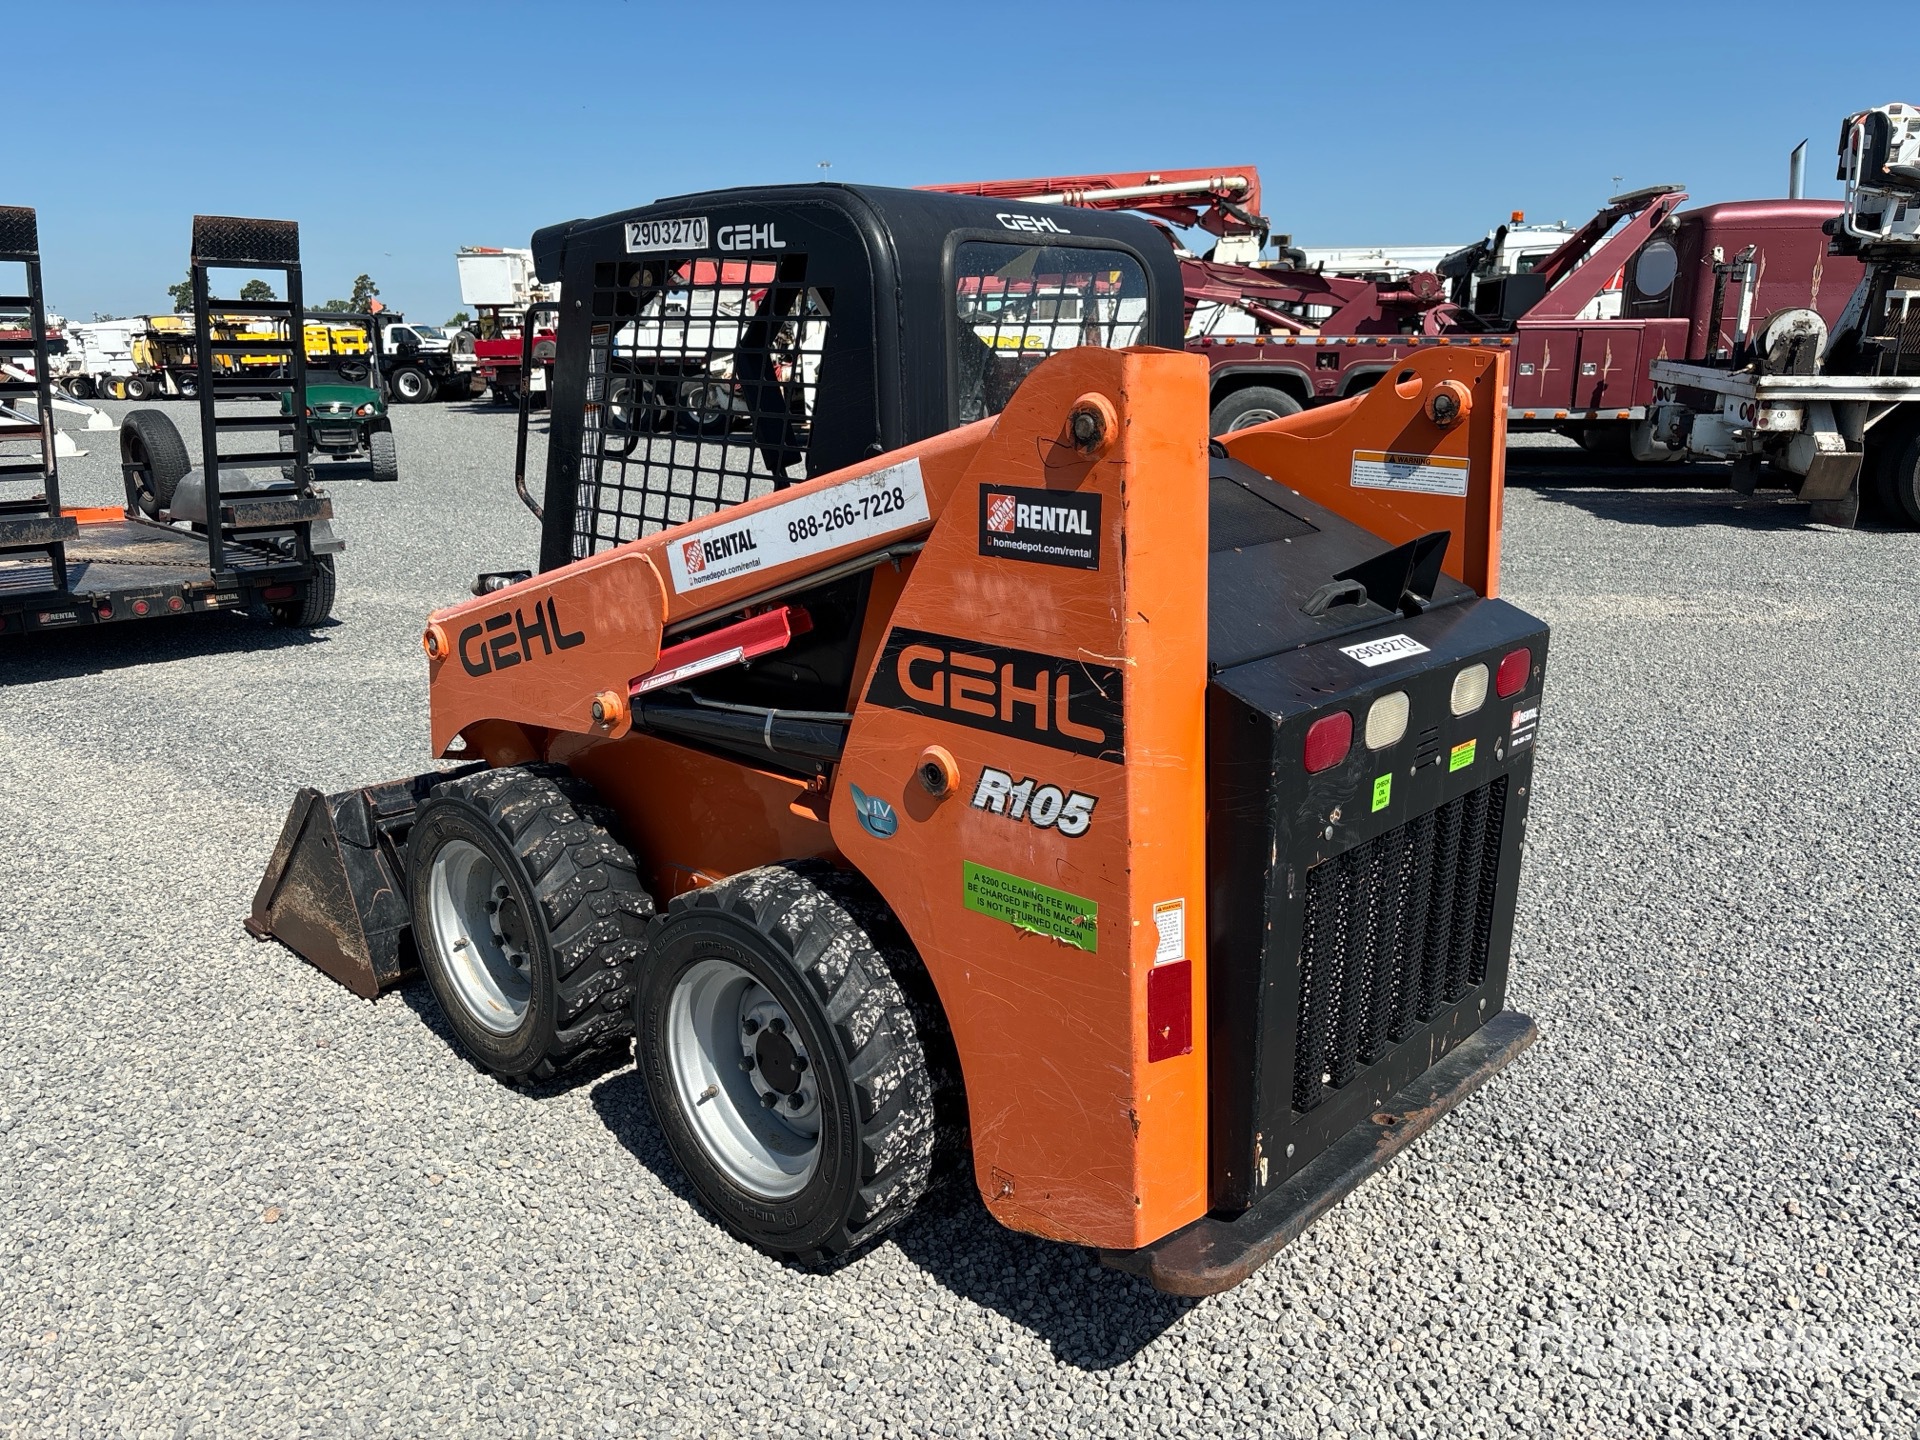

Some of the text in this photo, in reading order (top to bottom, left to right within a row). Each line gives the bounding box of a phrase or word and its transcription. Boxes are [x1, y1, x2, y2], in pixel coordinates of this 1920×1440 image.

[632, 219, 703, 246] 2903270
[717, 222, 786, 251] GEHL
[996, 213, 1071, 234] GEHL
[788, 487, 905, 543] 888-266-7228
[1016, 503, 1092, 536] RENTAL
[704, 529, 757, 563] RENTAL
[993, 536, 1092, 559] homedepot.com/rental
[694, 558, 761, 586] homedepot.com/rental
[215, 592, 240, 602] RENTAL
[50, 611, 77, 621] RENTAL
[458, 596, 585, 677] GEHL
[1347, 637, 1417, 660] 2903270
[897, 643, 1105, 745] GEHL
[972, 768, 1098, 837] R105
[967, 882, 979, 893] BE
[980, 885, 1021, 907] CHARGED
[1022, 900, 1031, 909] IF
[1033, 903, 1051, 917] THIS
[974, 873, 1085, 916] A $200 CLEANING FEE WILL
[977, 897, 1083, 940] IS NOT RETURNED CLEAN
